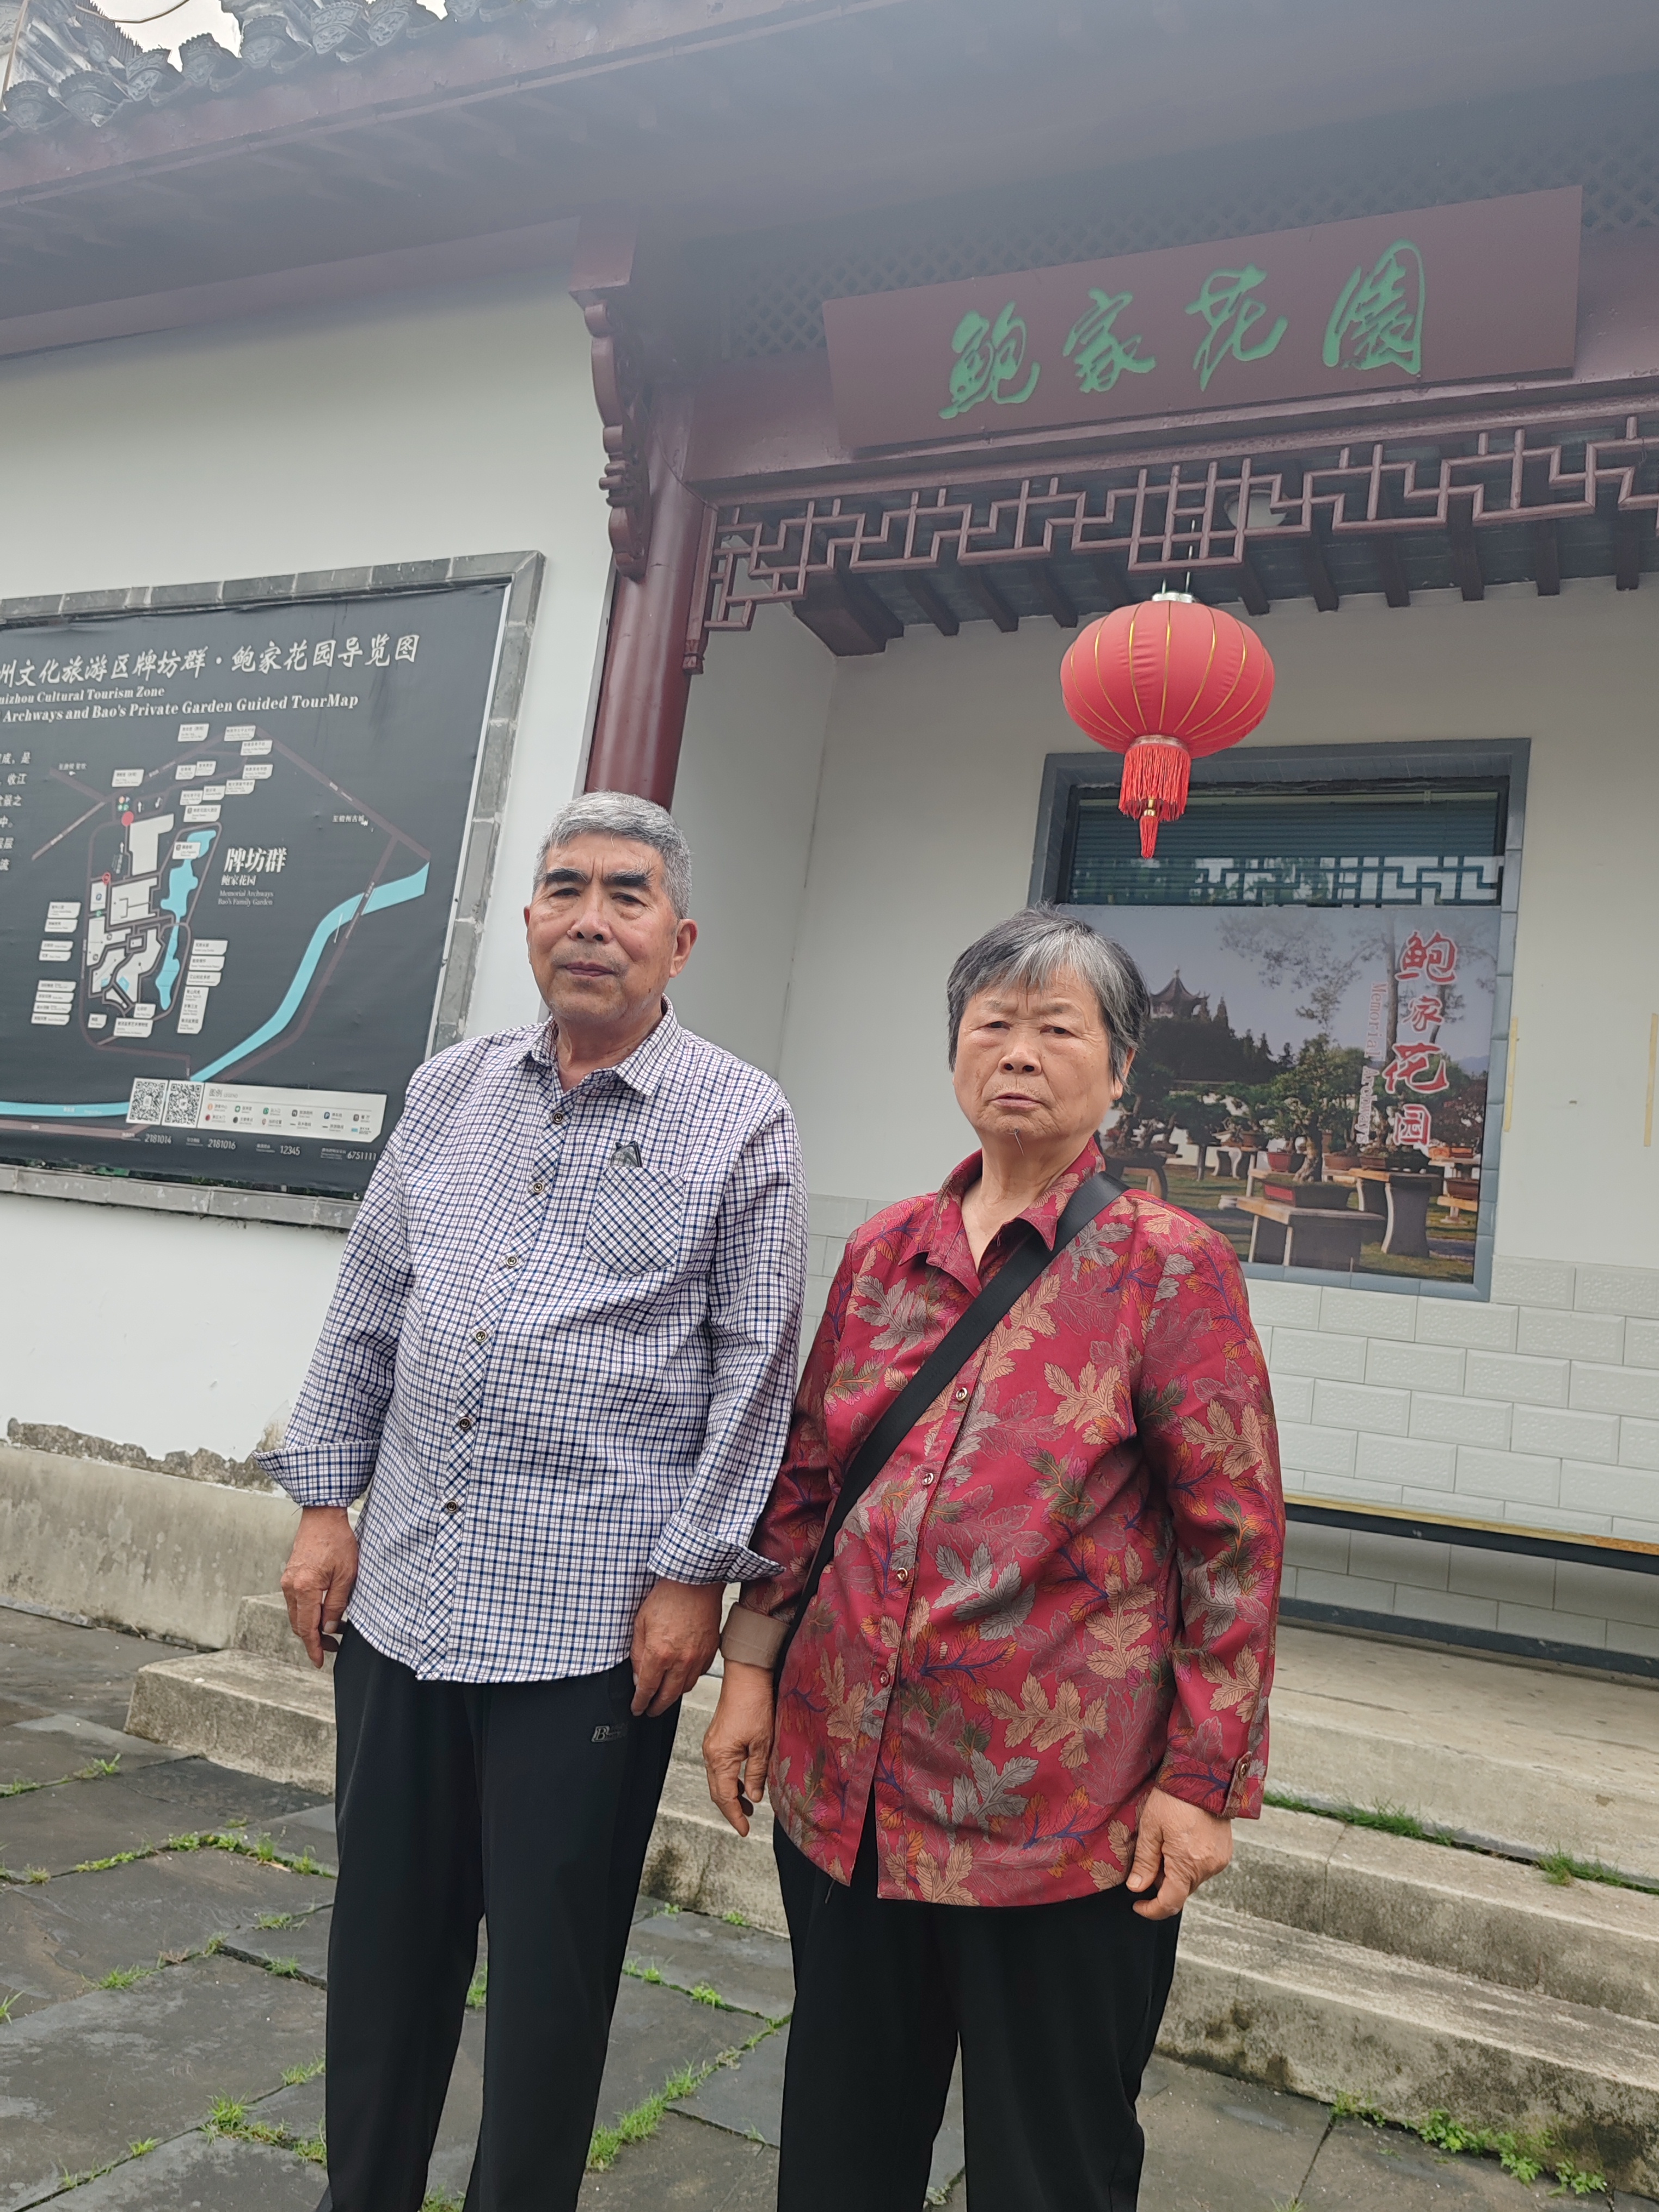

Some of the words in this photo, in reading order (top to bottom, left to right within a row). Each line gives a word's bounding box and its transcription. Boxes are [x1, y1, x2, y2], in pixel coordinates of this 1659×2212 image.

[36, 689, 84, 703] Cultural
[87, 687, 134, 701] Tourism
[136, 685, 165, 698] Zone
[2, 709, 64, 723] Archways
[65, 705, 90, 720] and
[92, 704, 127, 719] Bao's
[129, 703, 179, 717] Private
[182, 699, 232, 714] Garden
[236, 695, 288, 711] Guided
[223, 846, 287, 872] 牌坊群
[221, 874, 256, 886] 鲍家花园
[232, 898, 251, 907] Family
[1363, 981, 1387, 1058] Memorial
[1382, 930, 1458, 1145] 鲍家花园
[1355, 1065, 1380, 1144] Archways
[280, 1145, 301, 1156] 12345
[347, 1150, 377, 1161] 6751111
